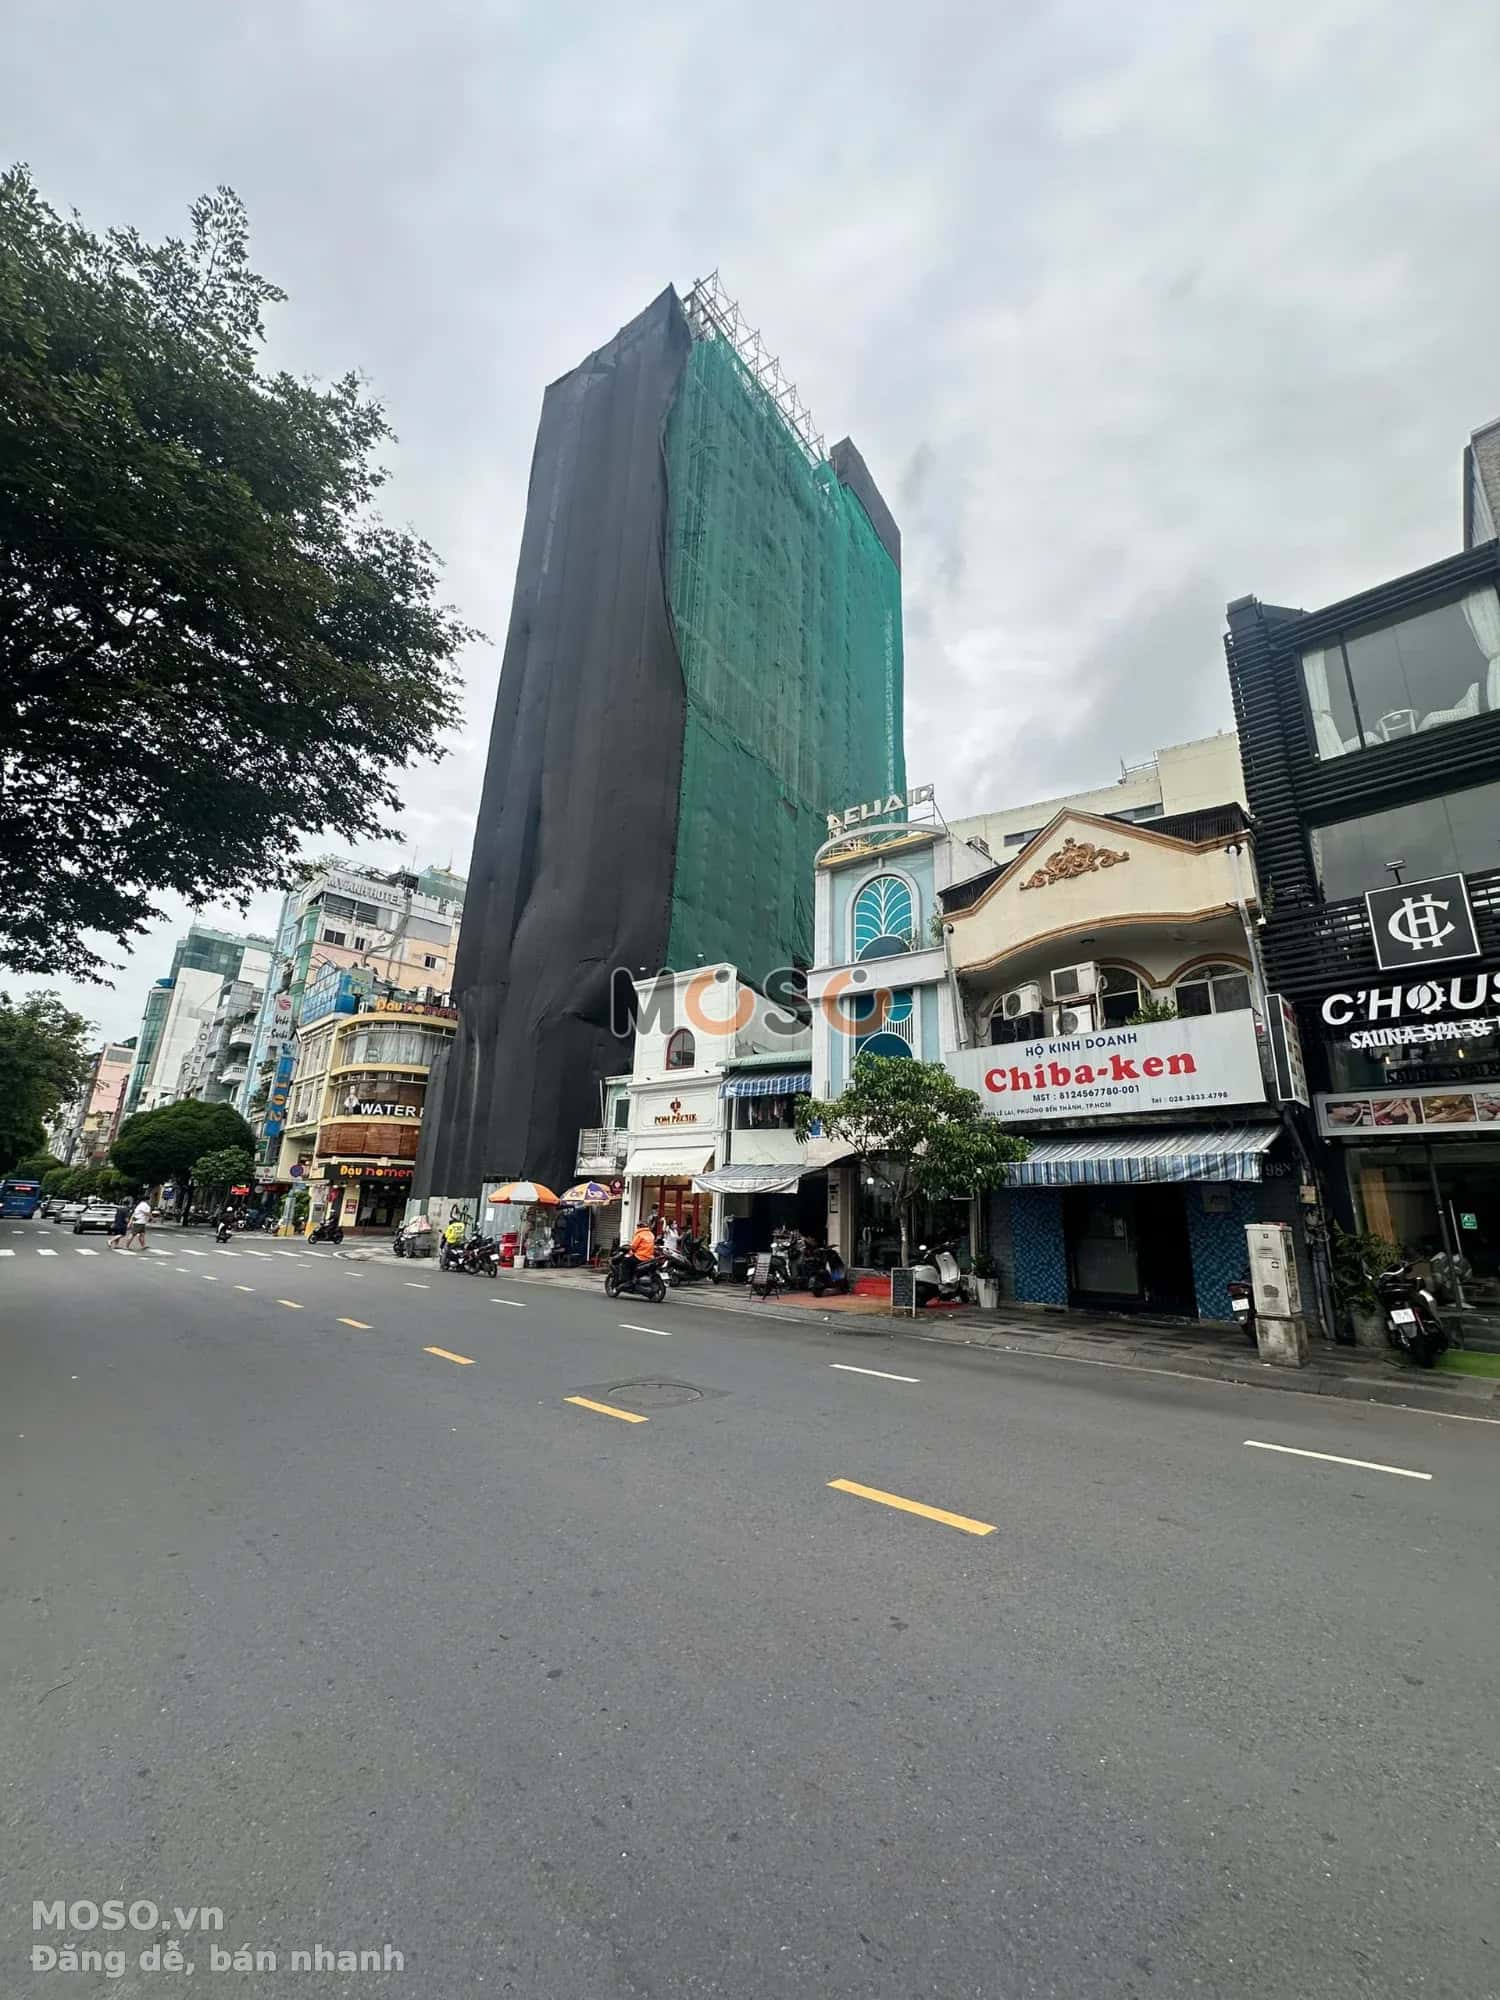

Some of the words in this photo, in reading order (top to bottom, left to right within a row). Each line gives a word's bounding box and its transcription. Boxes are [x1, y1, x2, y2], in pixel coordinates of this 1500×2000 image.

[1025, 1045, 1044, 1058] HỘ
[1050, 1040, 1080, 1055] KINH
[1085, 1033, 1138, 1050] DOANH
[1350, 1025, 1417, 1049] SAUNA
[1423, 1021, 1462, 1042] SPA
[984, 1052, 1197, 1093] Chiba-ken
[360, 1103, 416, 1117] WATER
[1032, 1093, 1050, 1102] MST
